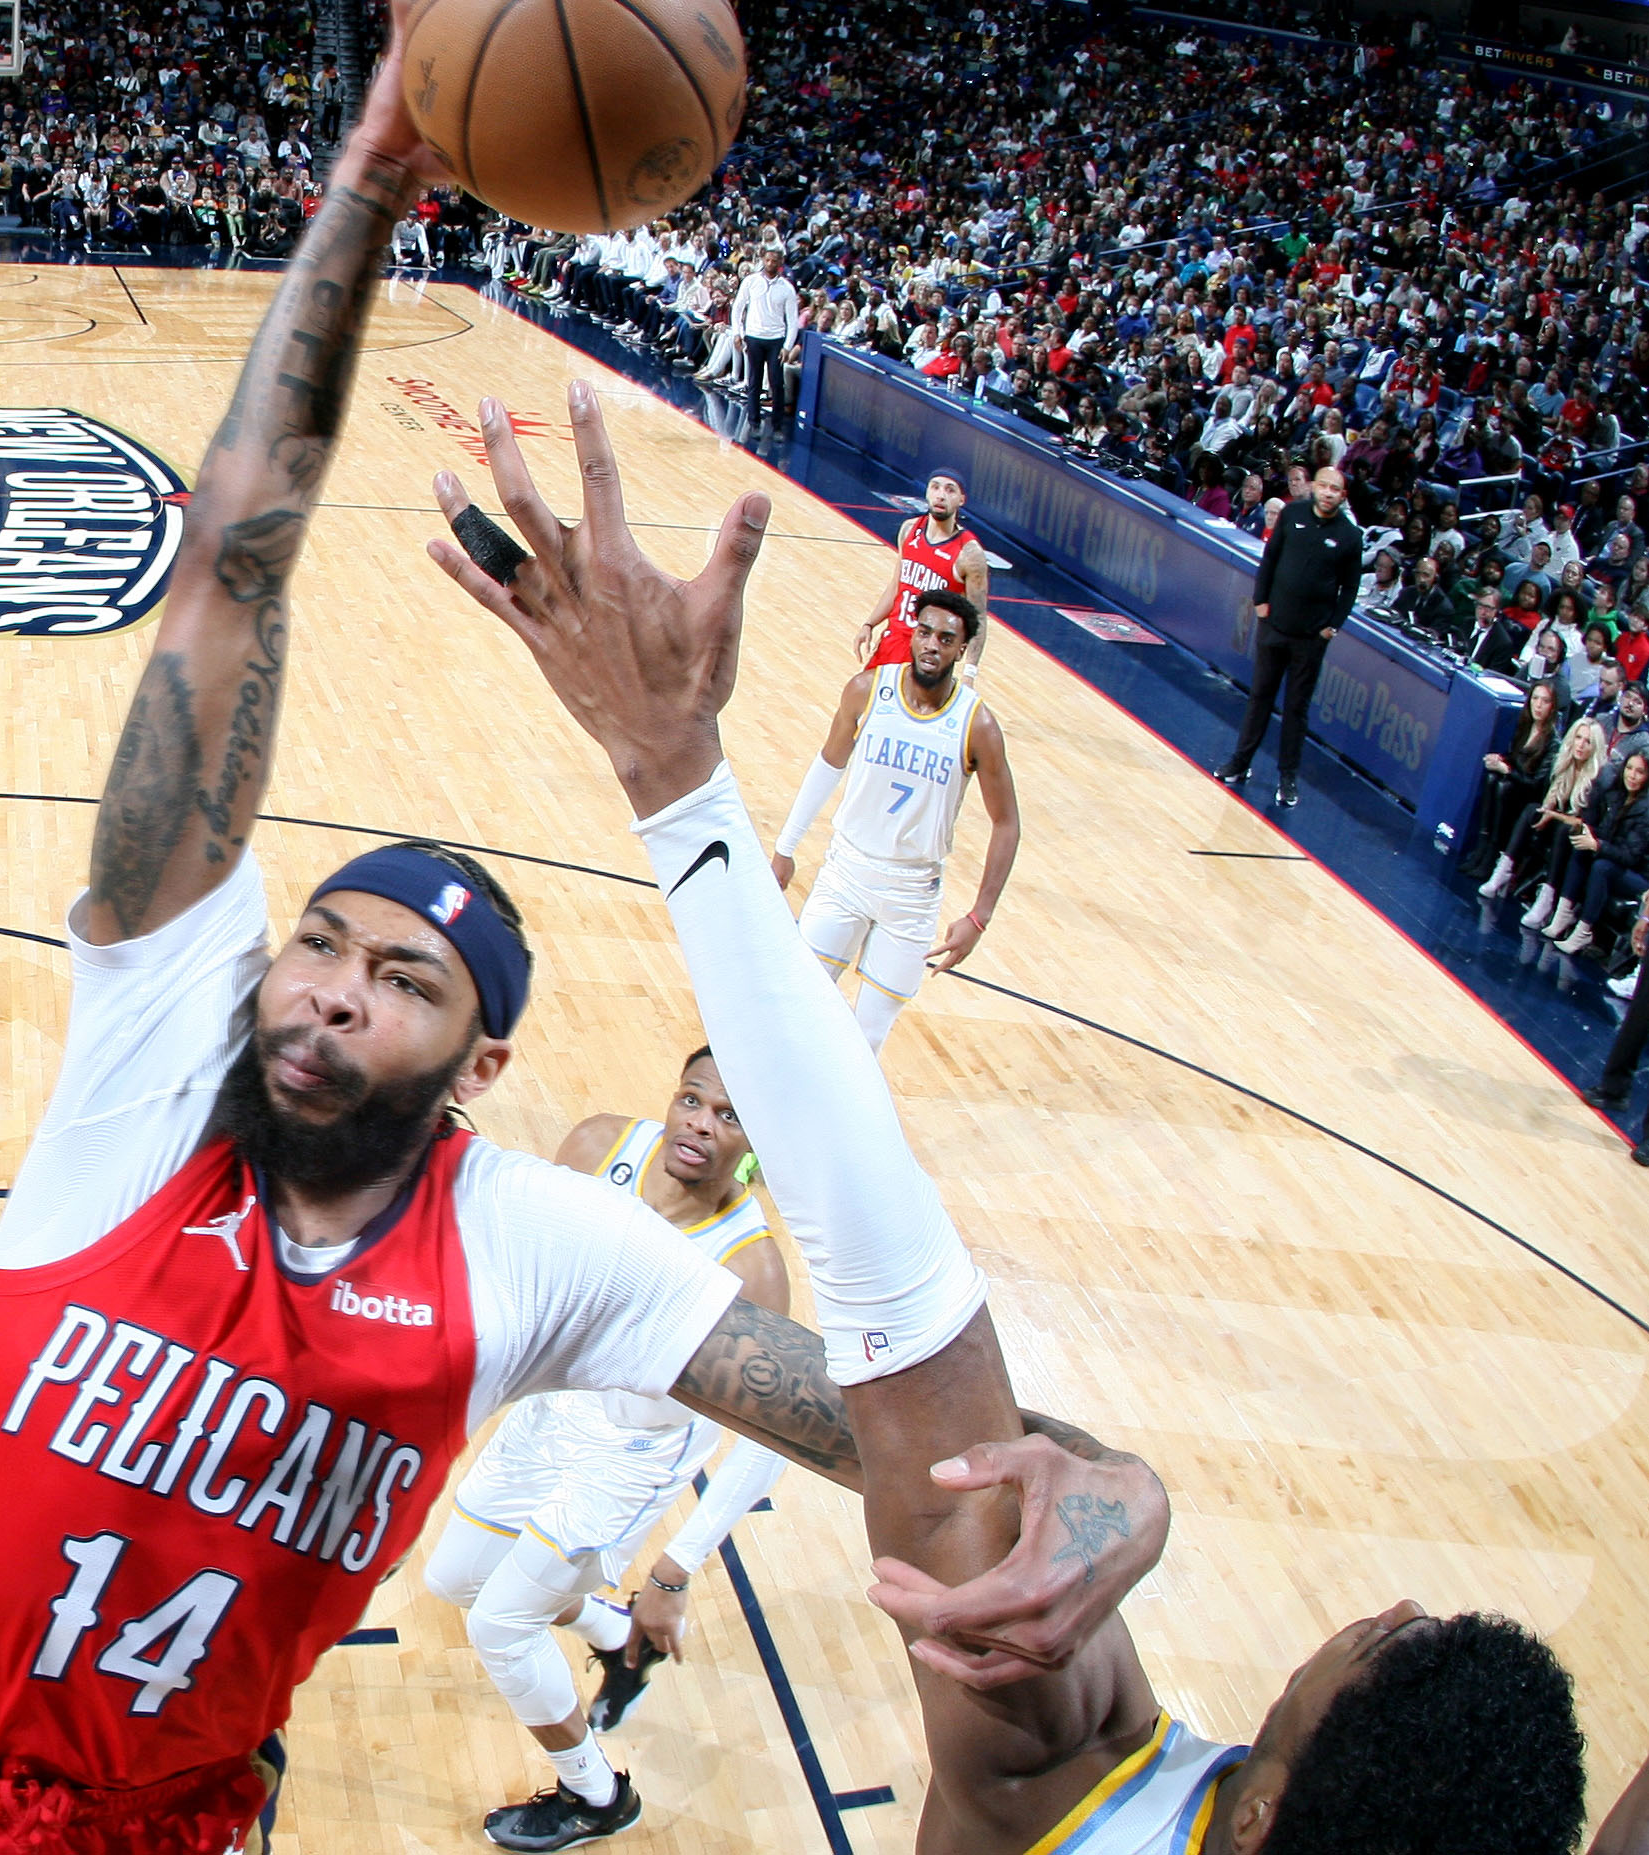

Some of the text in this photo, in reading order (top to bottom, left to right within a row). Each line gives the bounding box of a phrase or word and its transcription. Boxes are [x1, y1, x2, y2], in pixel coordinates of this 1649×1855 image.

[1475, 44, 1555, 69] BETRIVERS
[380, 402, 425, 432] CENTER
[386, 376, 480, 433] SMOOTHIE
[1035, 472, 1087, 557] LIVE
[1082, 500, 1165, 604] GAMES
[900, 559, 948, 592] ELICANS
[1364, 680, 1428, 771] Pass
[864, 733, 953, 785] LAKERS
[887, 781, 914, 814] 7
[612, 1164, 631, 1184] 6
[330, 1280, 433, 1327] ibotta
[0, 1303, 422, 1573] PELICANS
[30, 1529, 244, 1716] 14
